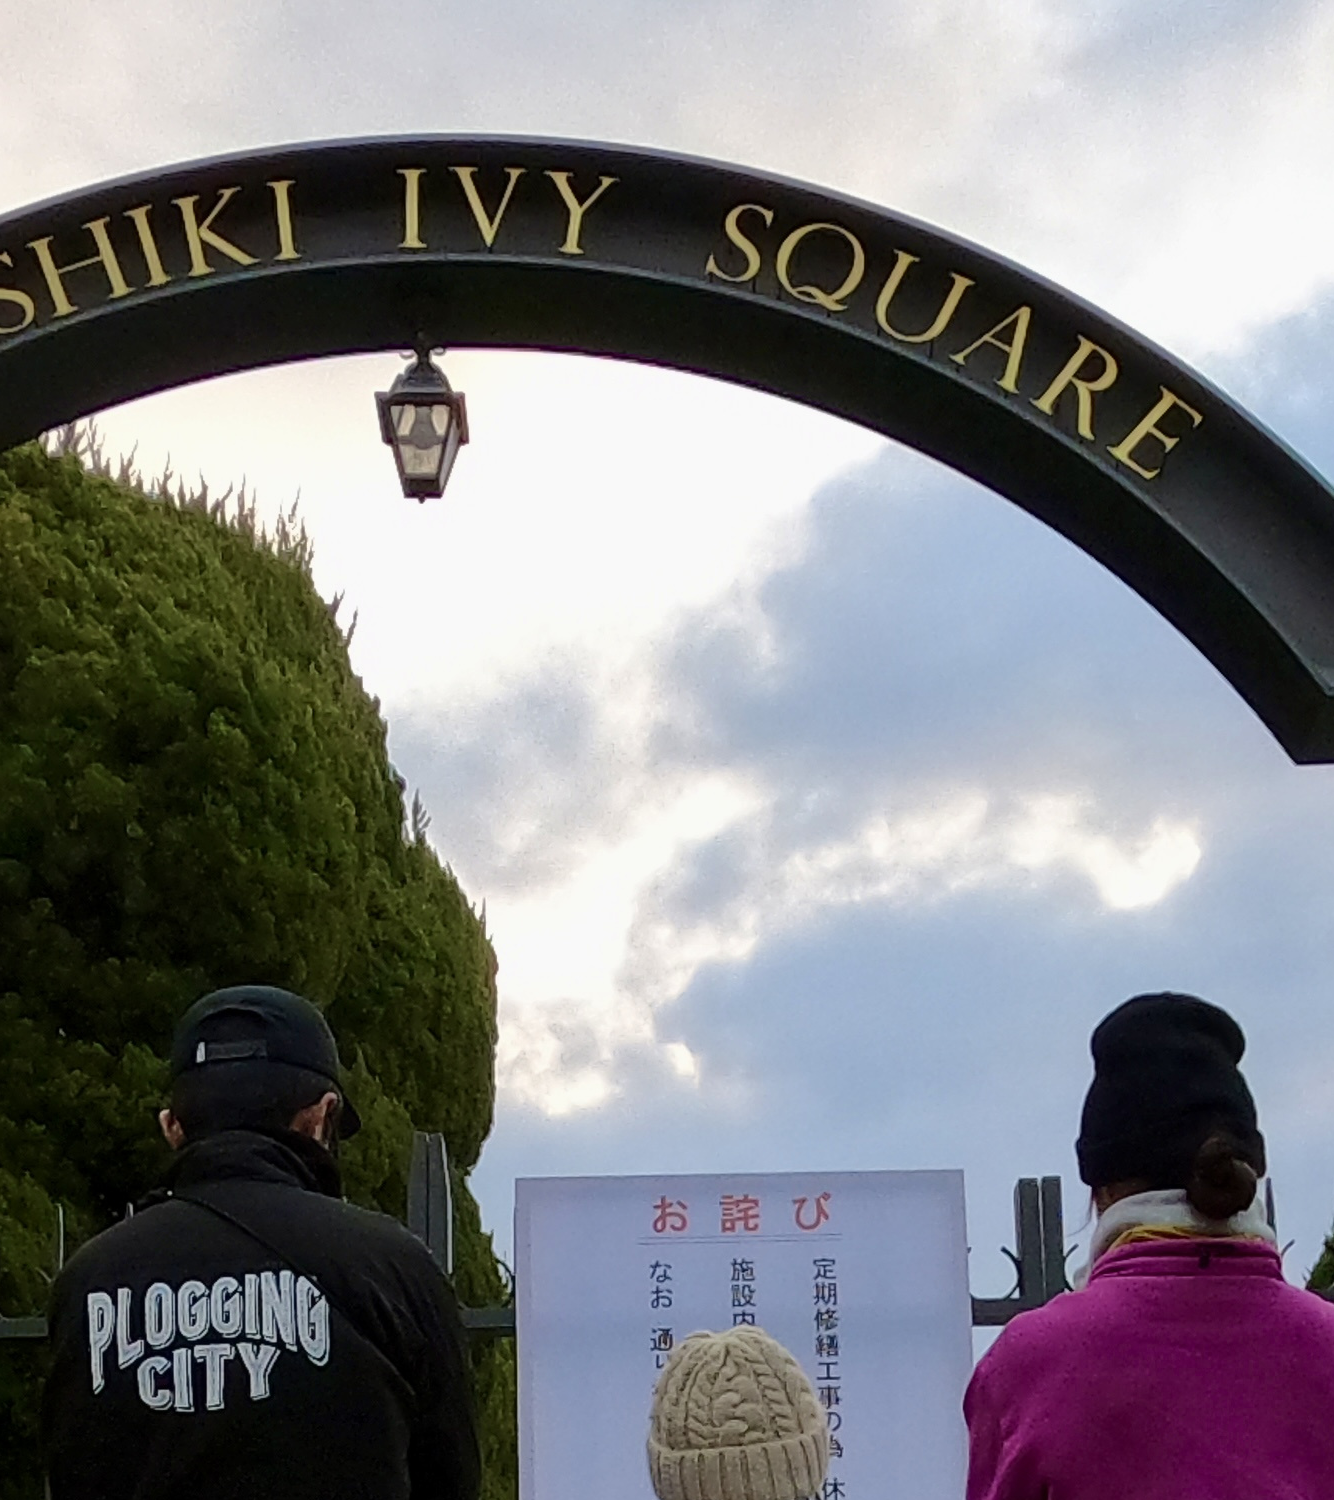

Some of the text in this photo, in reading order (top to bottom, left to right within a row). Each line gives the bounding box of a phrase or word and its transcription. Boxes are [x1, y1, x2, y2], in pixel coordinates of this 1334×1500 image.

[395, 166, 621, 257] IVY
[704, 202, 1204, 484] SQUARE
[652, 1191, 832, 1234] お詫び
[648, 1259, 674, 1309] なお
[87, 1269, 331, 1395] PLOGGING
[136, 1342, 281, 1413] CITY
